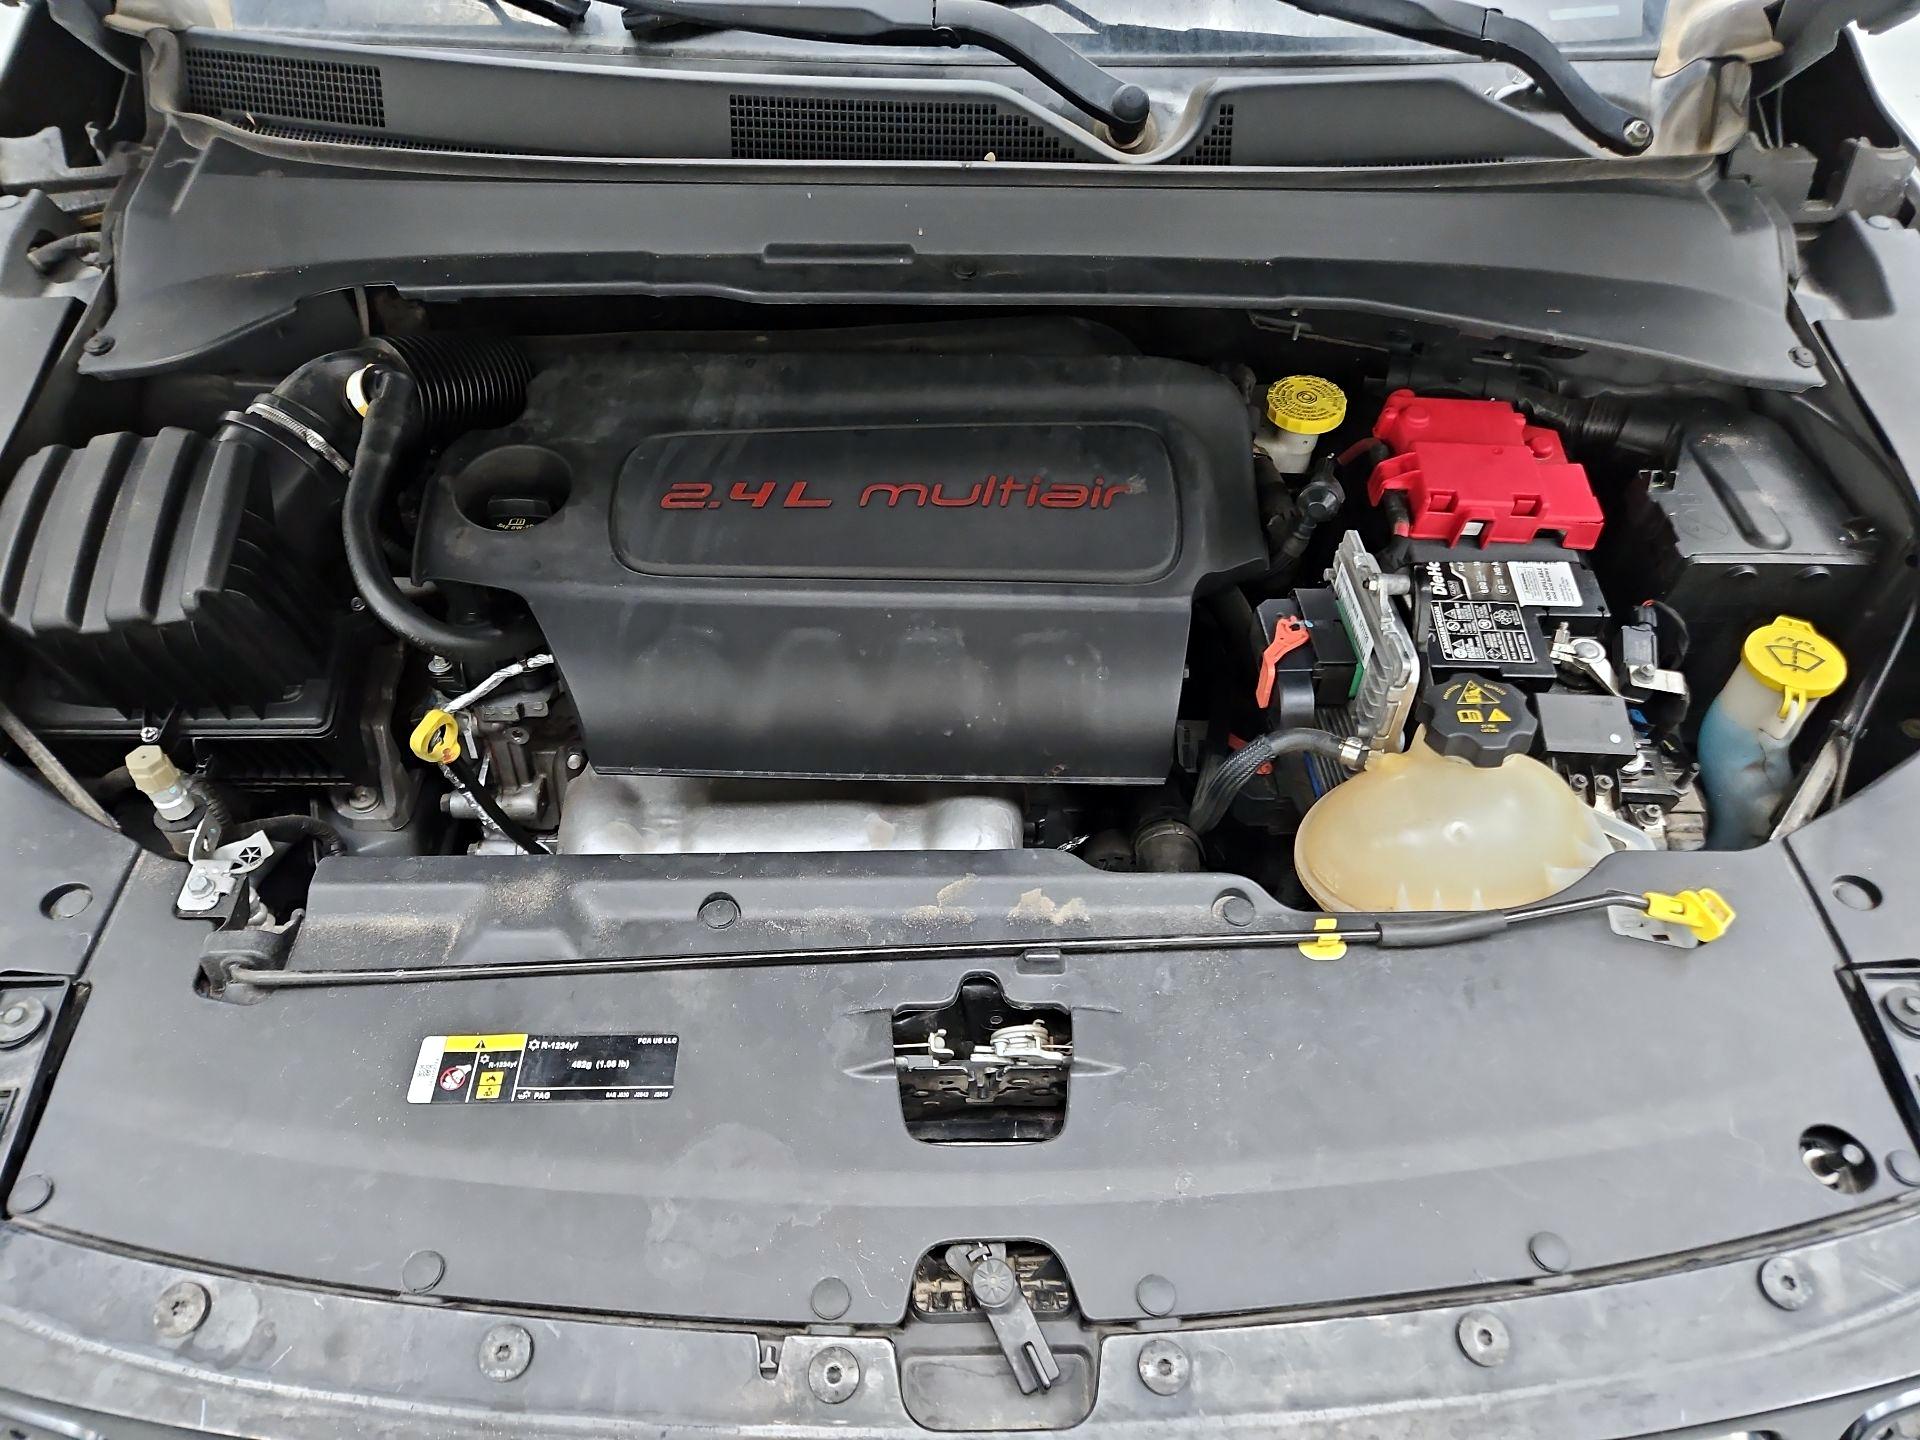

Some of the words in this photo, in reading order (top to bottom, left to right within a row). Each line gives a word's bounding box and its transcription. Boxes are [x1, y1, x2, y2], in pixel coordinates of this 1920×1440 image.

[858, 475, 1132, 509] multiair
[541, 1042, 579, 1051] R-1234yf
[618, 1059, 630, 1070] lb)
